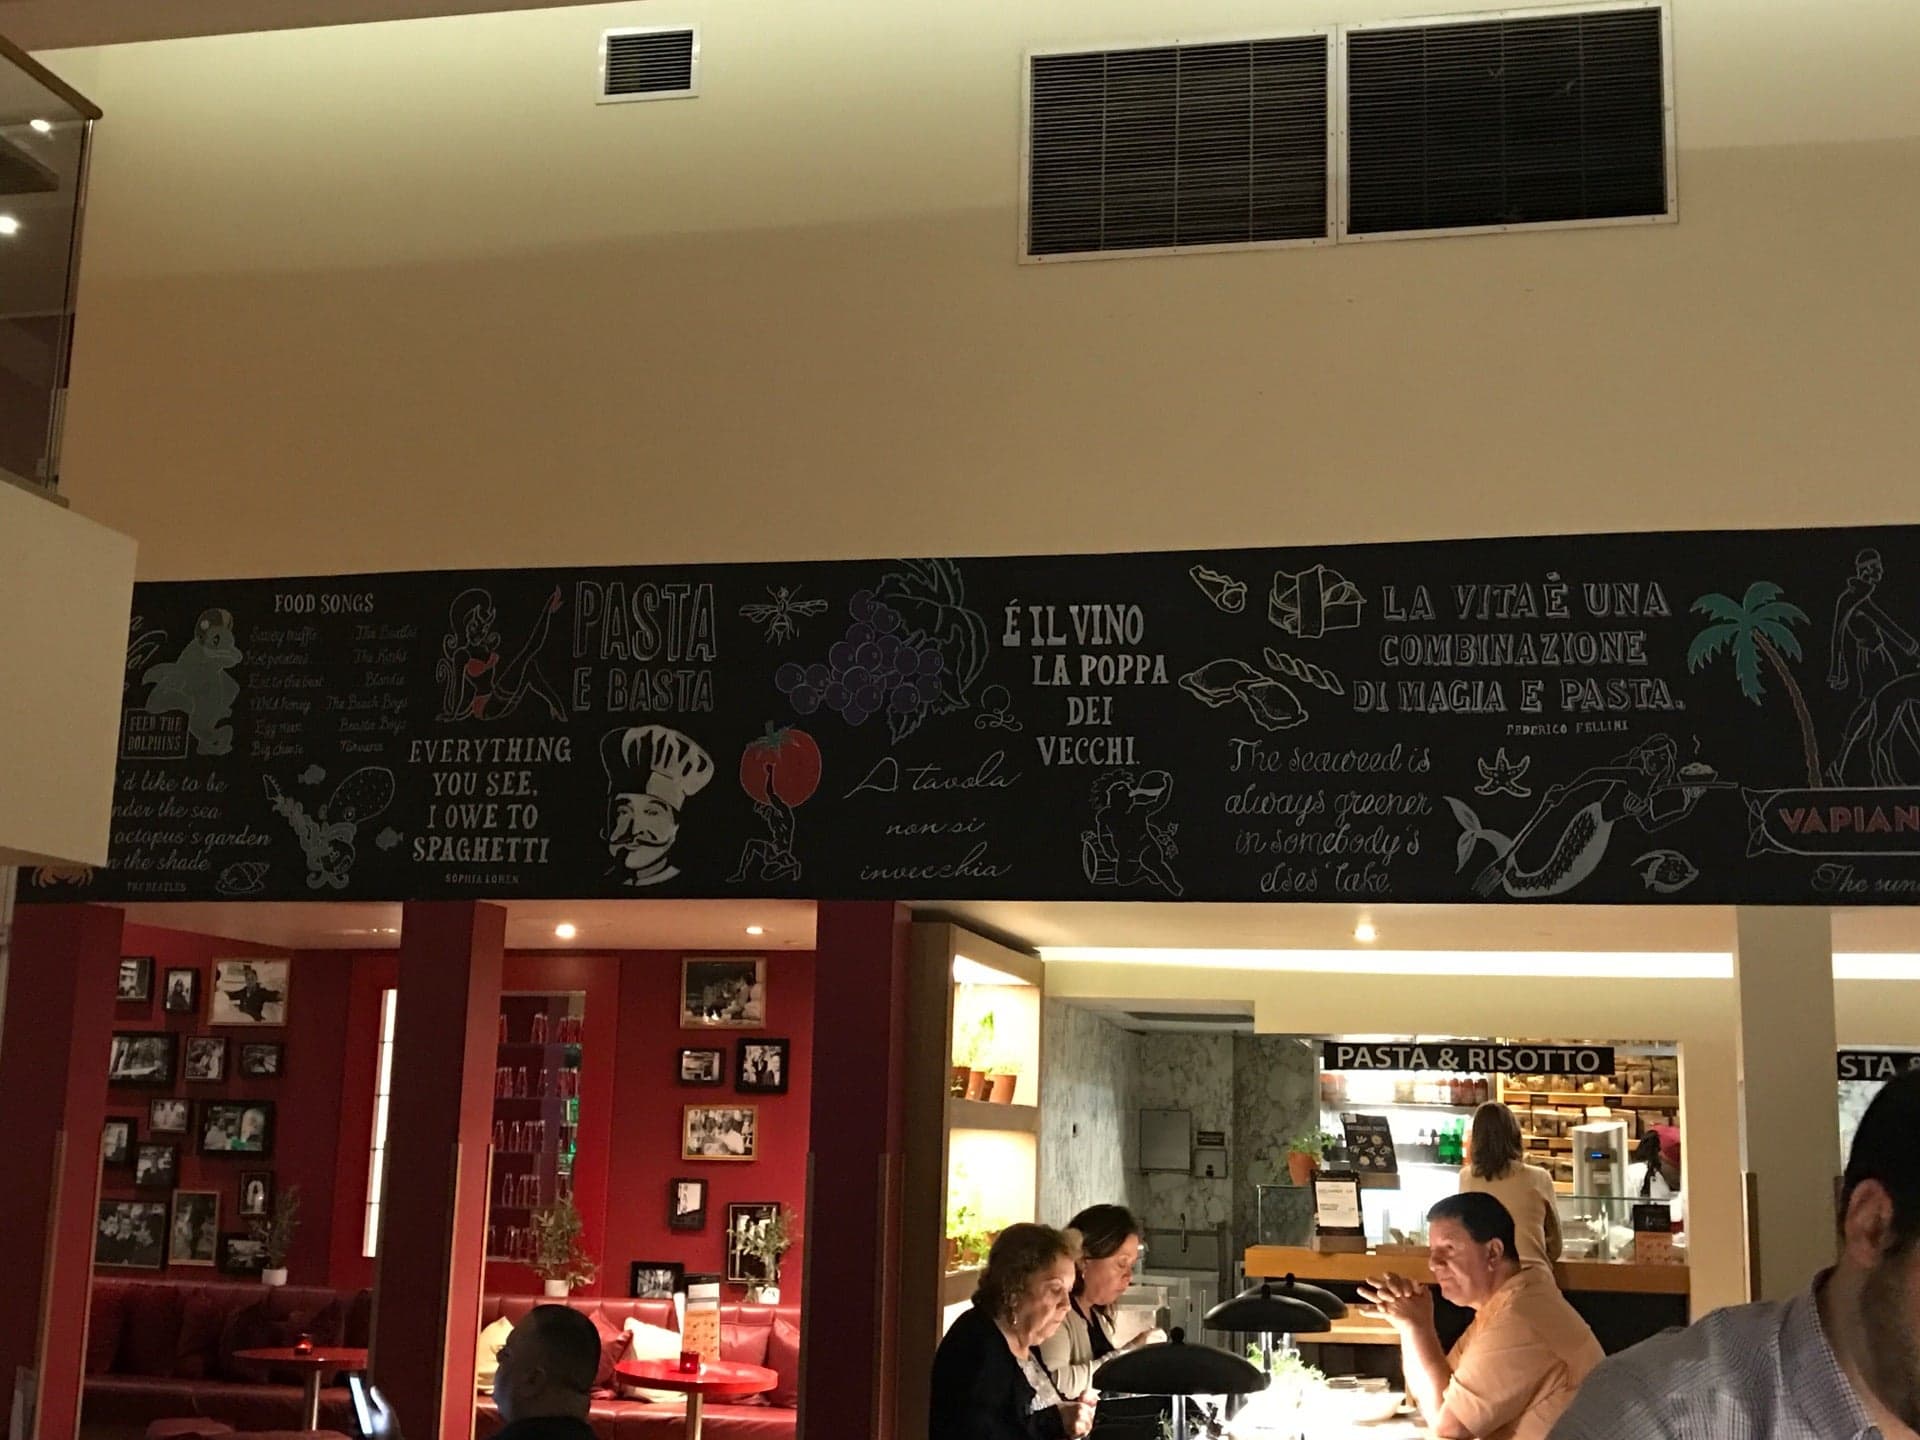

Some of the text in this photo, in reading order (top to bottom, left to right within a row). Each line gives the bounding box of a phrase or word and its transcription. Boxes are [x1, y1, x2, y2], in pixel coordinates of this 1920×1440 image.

[274, 592, 375, 614] FOOD SONGS
[1382, 584, 1436, 622] LA
[1451, 581, 1539, 621] VITA
[1583, 581, 1673, 619] UNA
[573, 580, 717, 662] PASTA
[1029, 605, 1067, 647] IL
[1068, 603, 1145, 646] VINO
[1379, 630, 1649, 668] COMBINAZIONE
[1031, 654, 1170, 687] LA POPPA
[572, 666, 715, 713] E BASTA
[1352, 677, 1687, 714] DI MAGIA E PASTA.
[160, 713, 185, 732] THE
[1066, 696, 1113, 727] DEI
[1505, 723, 1568, 736] FEDERICO
[407, 736, 573, 764] EVERYTHING
[1036, 736, 1141, 767] VECCHI.
[1229, 738, 1431, 773] The seaweed is
[121, 768, 230, 792] 'd like to be
[432, 771, 477, 797] YOU
[904, 750, 1023, 792] tavola
[111, 795, 222, 819] nder the sea
[426, 803, 539, 829] I OWE TO
[1224, 783, 1433, 829] always greener
[1778, 805, 1920, 834] VAPIAN
[203, 824, 272, 854] garden
[885, 821, 948, 836] non
[107, 848, 211, 871] n the shade
[412, 836, 550, 865] SPAGHETTI
[1235, 823, 1421, 866] in somebody's
[1811, 863, 1868, 893] The
[1336, 1046, 1601, 1073] PASTA & RISOTTO
[1840, 1055, 1897, 1079] STA
